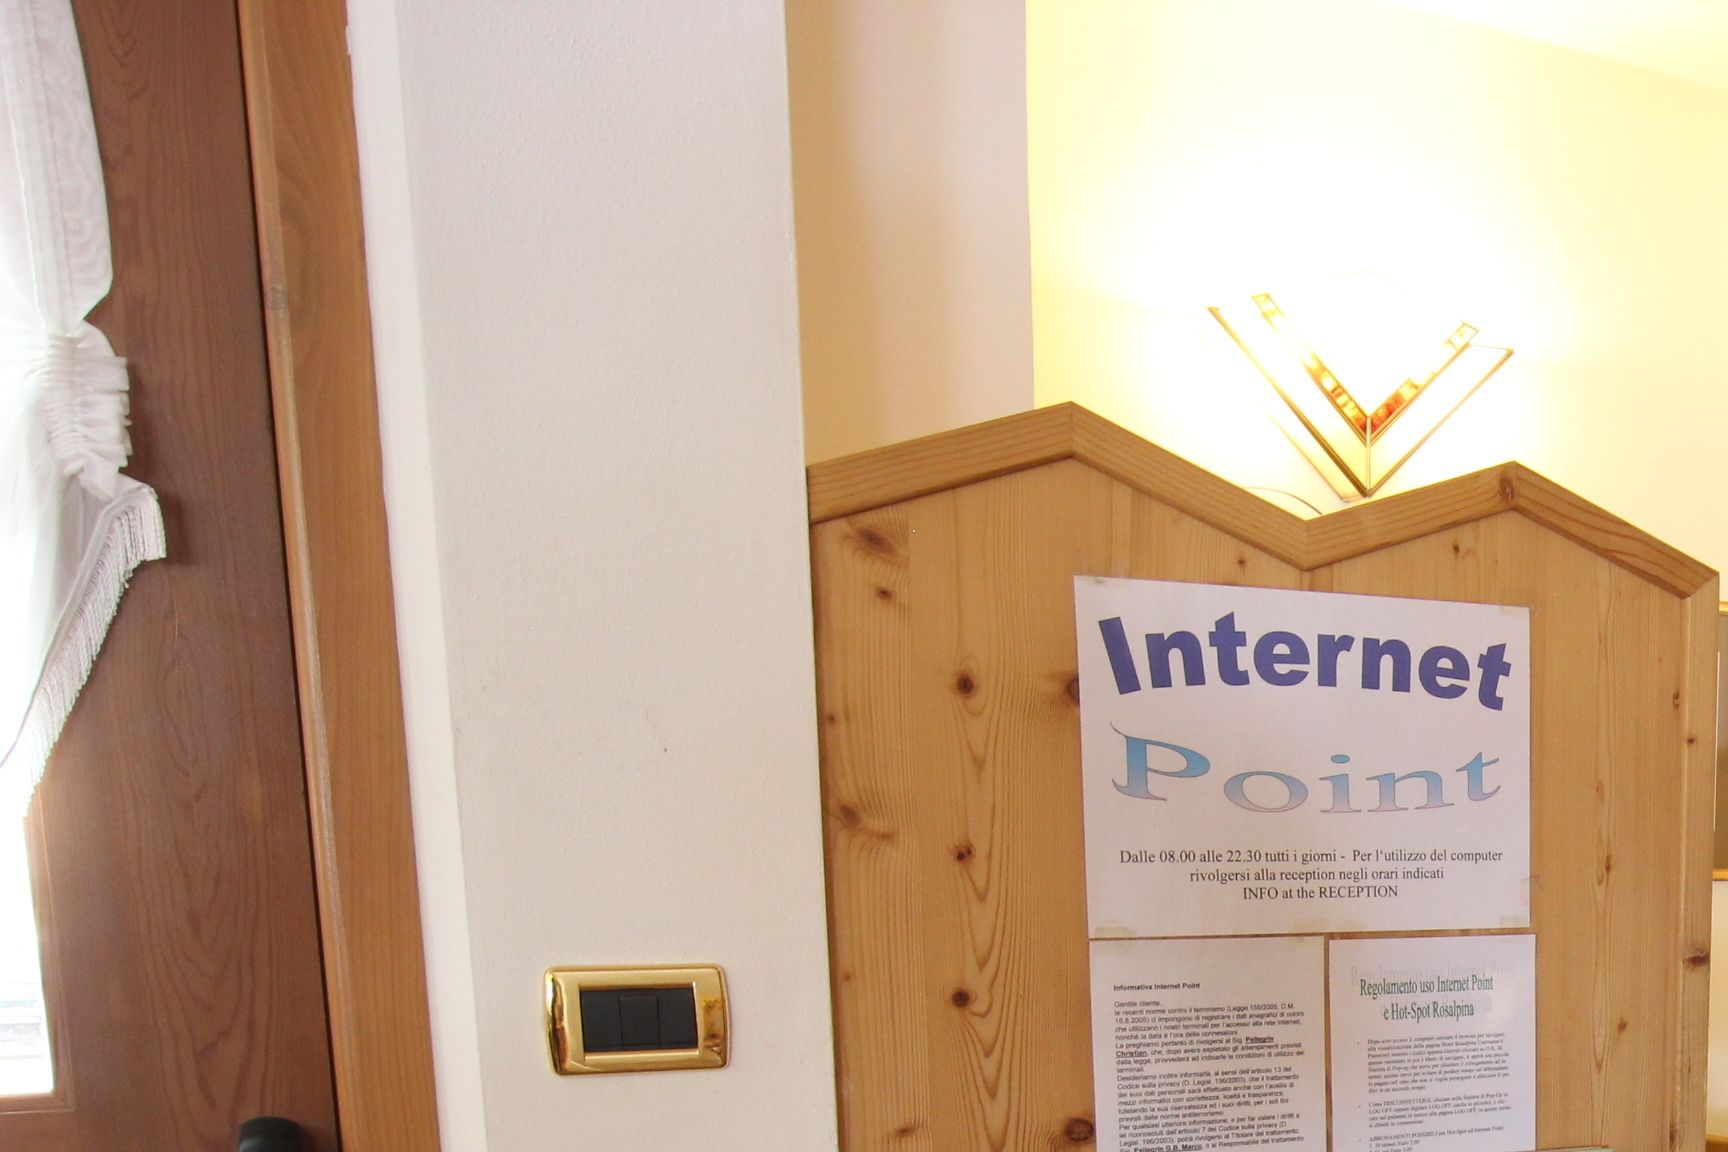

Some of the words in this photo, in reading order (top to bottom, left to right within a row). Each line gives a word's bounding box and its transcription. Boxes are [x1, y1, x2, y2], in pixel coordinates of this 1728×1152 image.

[1097, 611, 1512, 712] Internet
[1109, 720, 1502, 816] Point
[1120, 850, 1156, 864] Dalle
[1159, 850, 1196, 863] 08.00
[1199, 849, 1223, 863] alle
[1226, 849, 1262, 863] 22.30
[1264, 849, 1290, 863] tutti
[1301, 849, 1337, 866] giorni
[1352, 849, 1373, 862] Per
[1375, 848, 1427, 862] l'utilizzo
[1429, 849, 1447, 862] del
[1450, 851, 1503, 865] computer
[1190, 868, 1250, 885] rivolgersi
[1254, 868, 1276, 881] alla
[1279, 867, 1336, 884] reception
[1338, 867, 1368, 883] negli
[1371, 867, 1398, 880] orari
[1402, 866, 1444, 880] indicati
[1243, 886, 1279, 900] INFO
[1282, 888, 1293, 899] at
[1296, 886, 1315, 899] the
[1319, 885, 1398, 899] RECEPTION
[1360, 977, 1418, 999] Regolamento
[1420, 981, 1435, 993] uso
[1437, 976, 1469, 992] Internet
[1472, 974, 1493, 990] Point
[1384, 1009, 1389, 1020] e
[1392, 1003, 1430, 1023] Hot-Spot
[1433, 1000, 1474, 1021] Rosalpina
